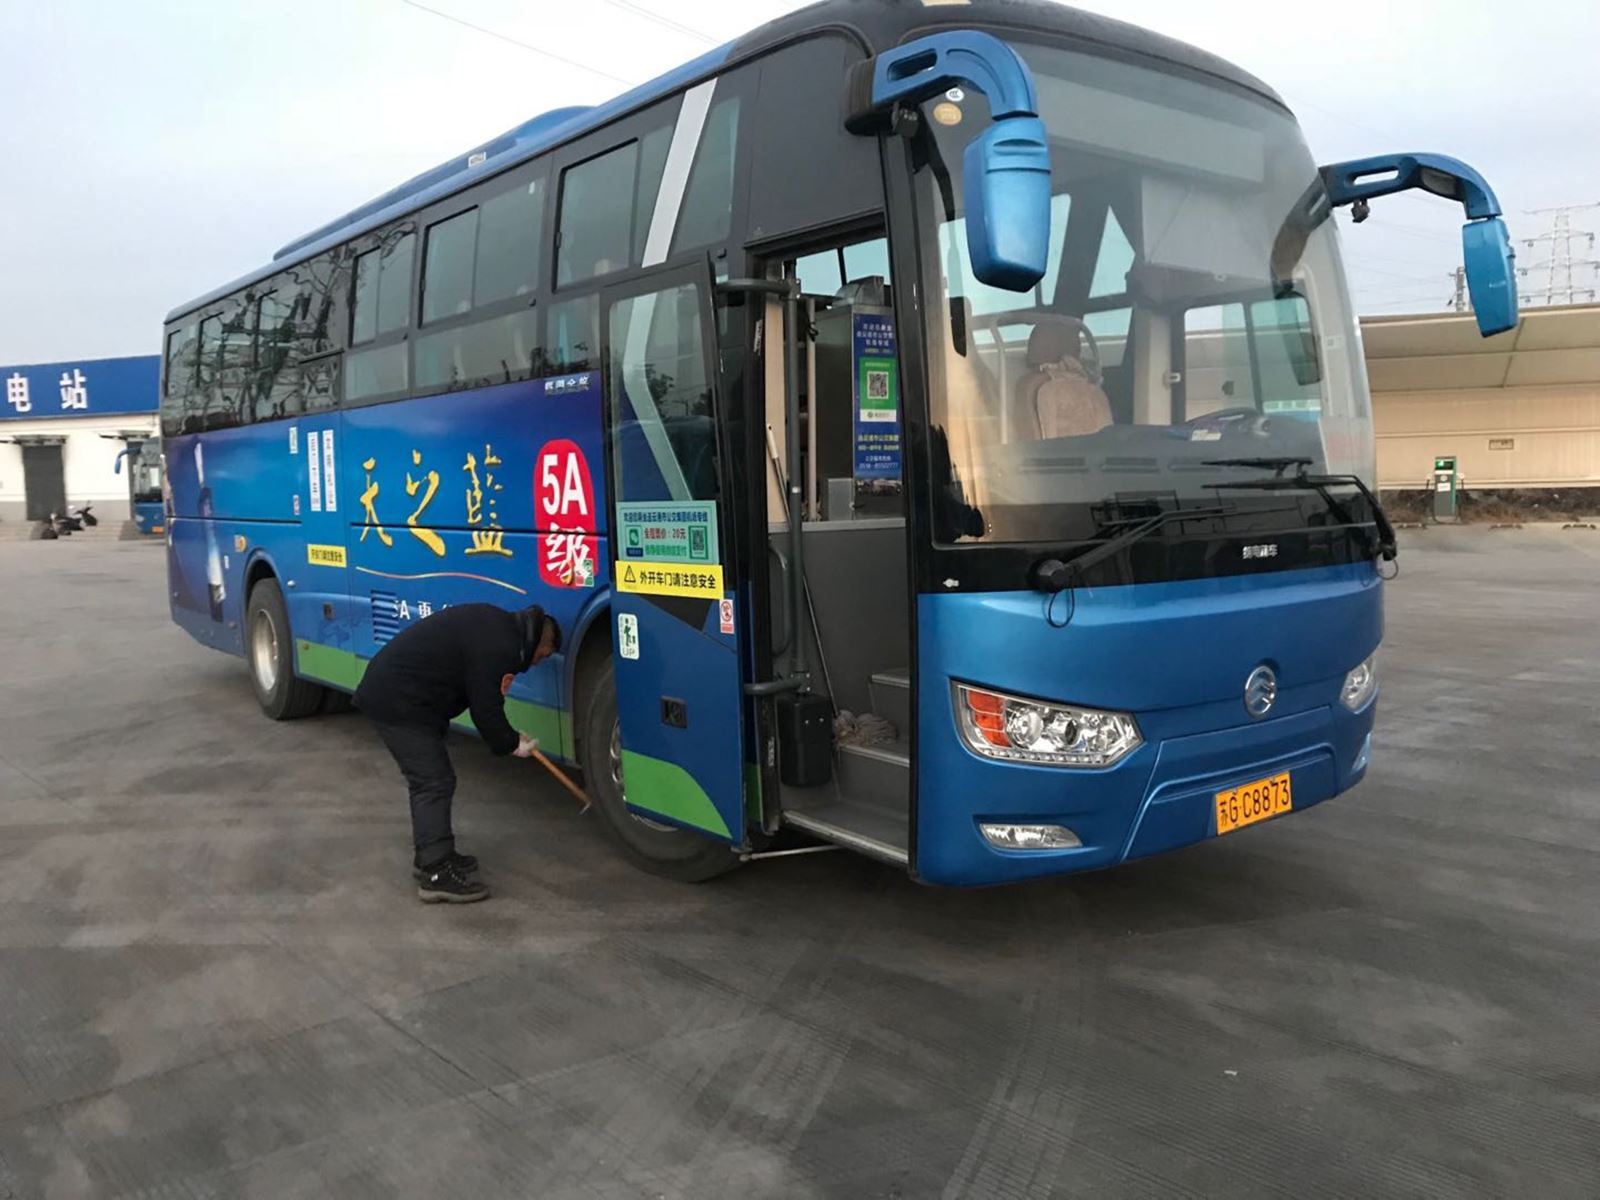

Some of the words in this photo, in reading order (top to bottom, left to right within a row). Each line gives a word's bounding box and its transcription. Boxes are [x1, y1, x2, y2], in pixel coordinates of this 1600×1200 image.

[542, 452, 588, 515] 5A
[640, 571, 716, 589] 外开车门请注意安全
